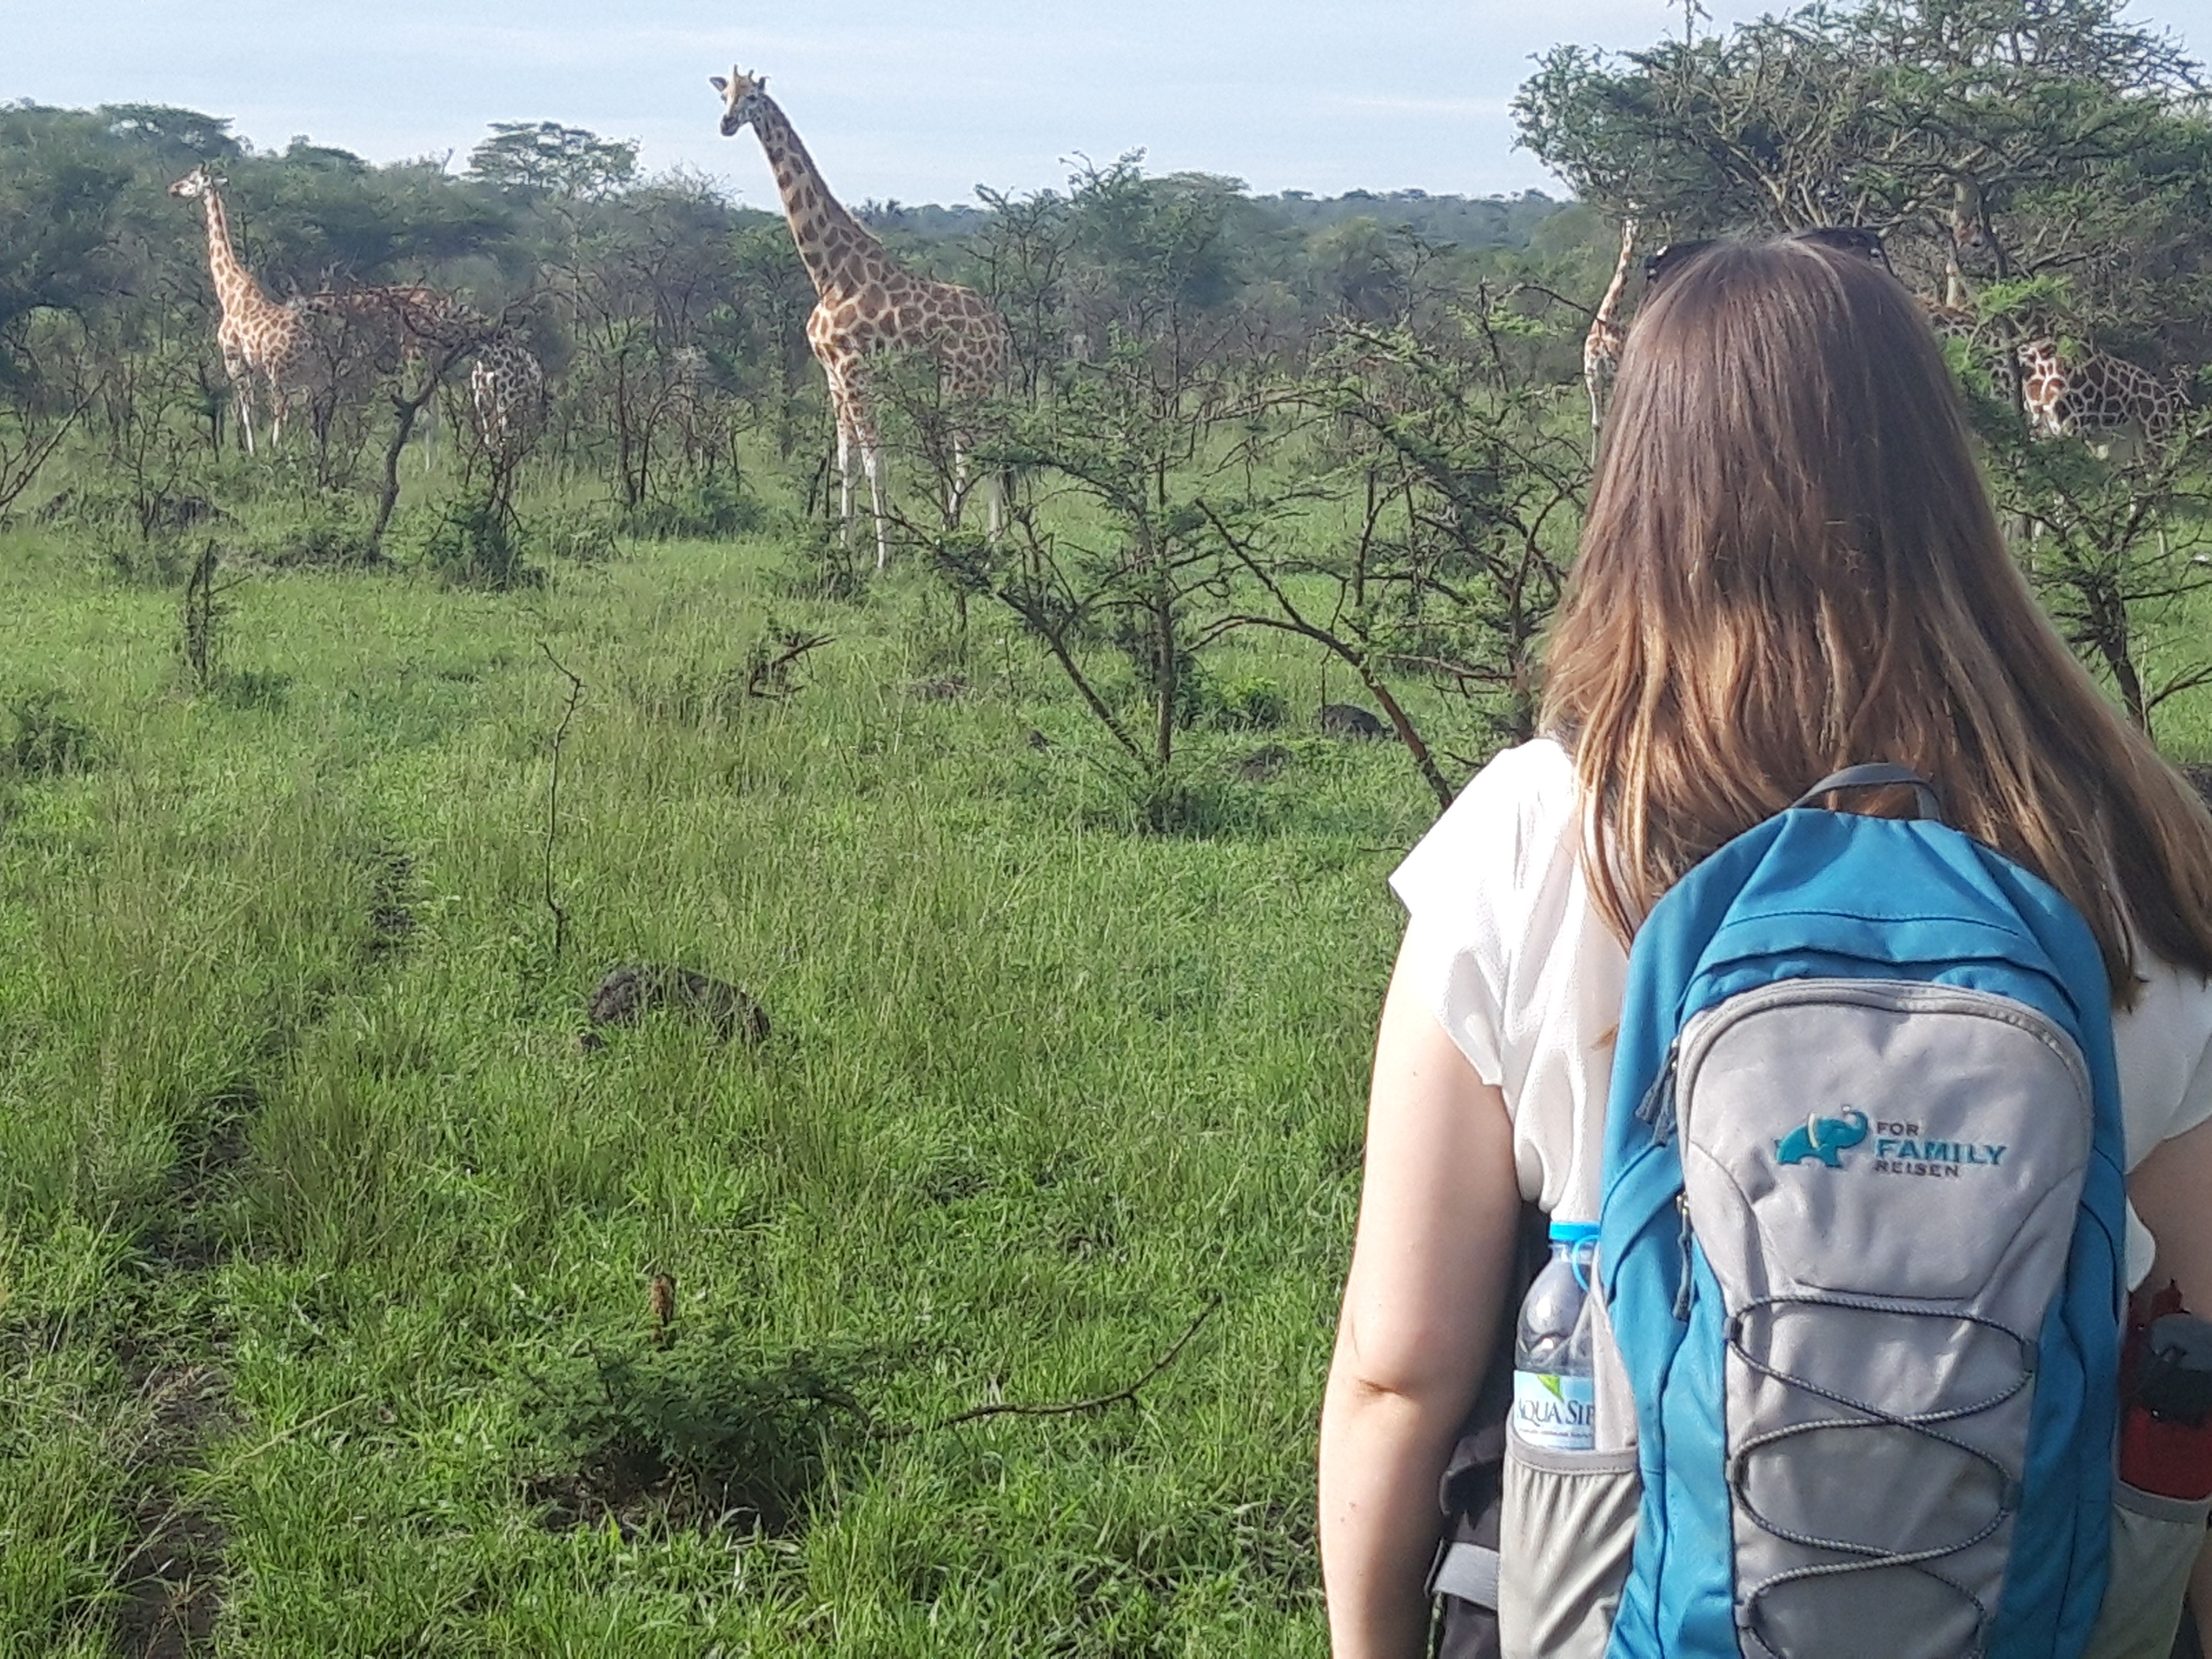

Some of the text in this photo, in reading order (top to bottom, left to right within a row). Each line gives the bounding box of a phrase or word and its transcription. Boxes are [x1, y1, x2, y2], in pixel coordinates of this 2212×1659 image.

[1877, 1121, 1919, 1136] FOR
[1875, 1139, 2007, 1165] FAMILY
[1874, 1160, 1959, 1177] REISEN
